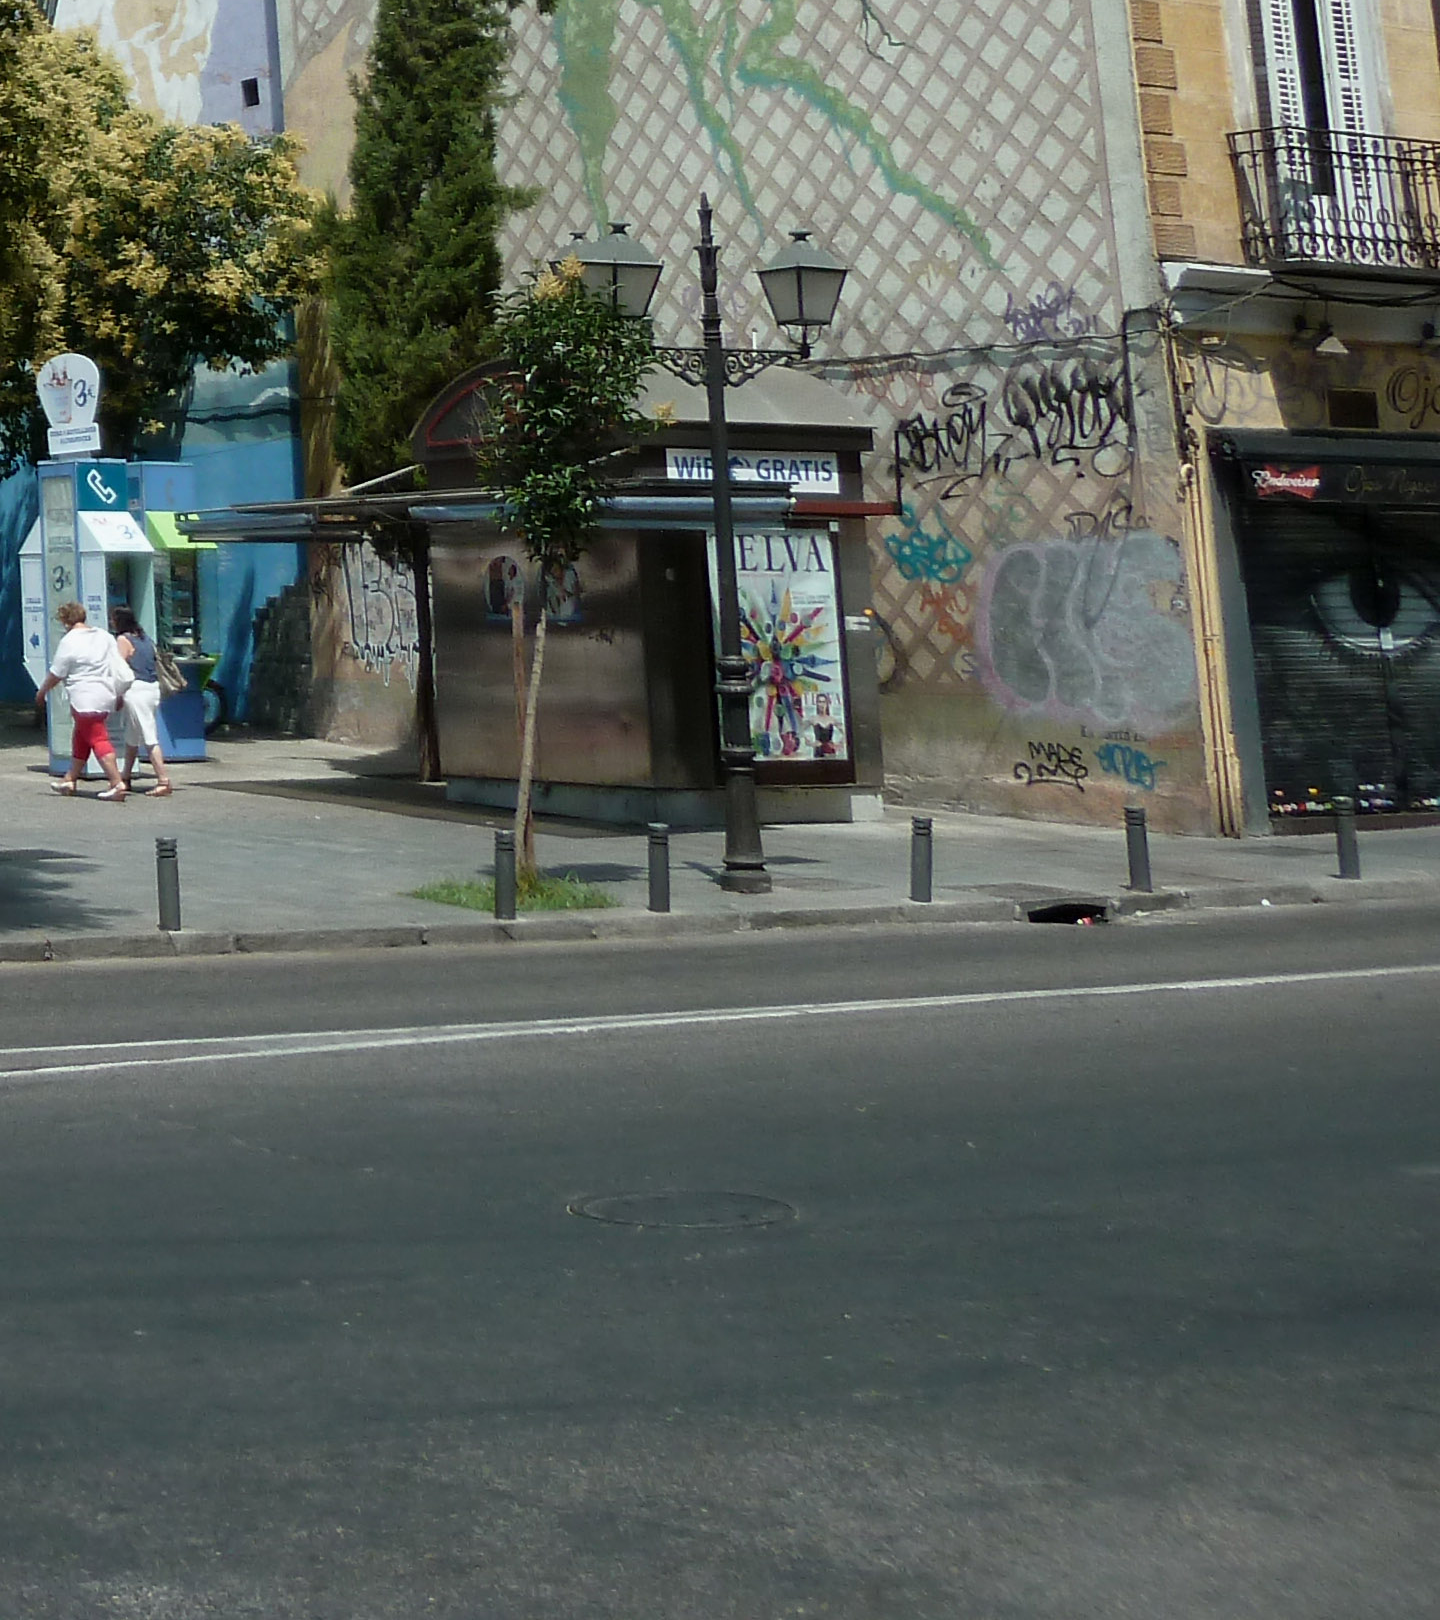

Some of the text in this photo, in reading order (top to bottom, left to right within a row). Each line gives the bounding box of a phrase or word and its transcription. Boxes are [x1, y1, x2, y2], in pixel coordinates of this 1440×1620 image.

[673, 455, 833, 482] WiF GRATIS
[709, 533, 829, 572] ELVA
